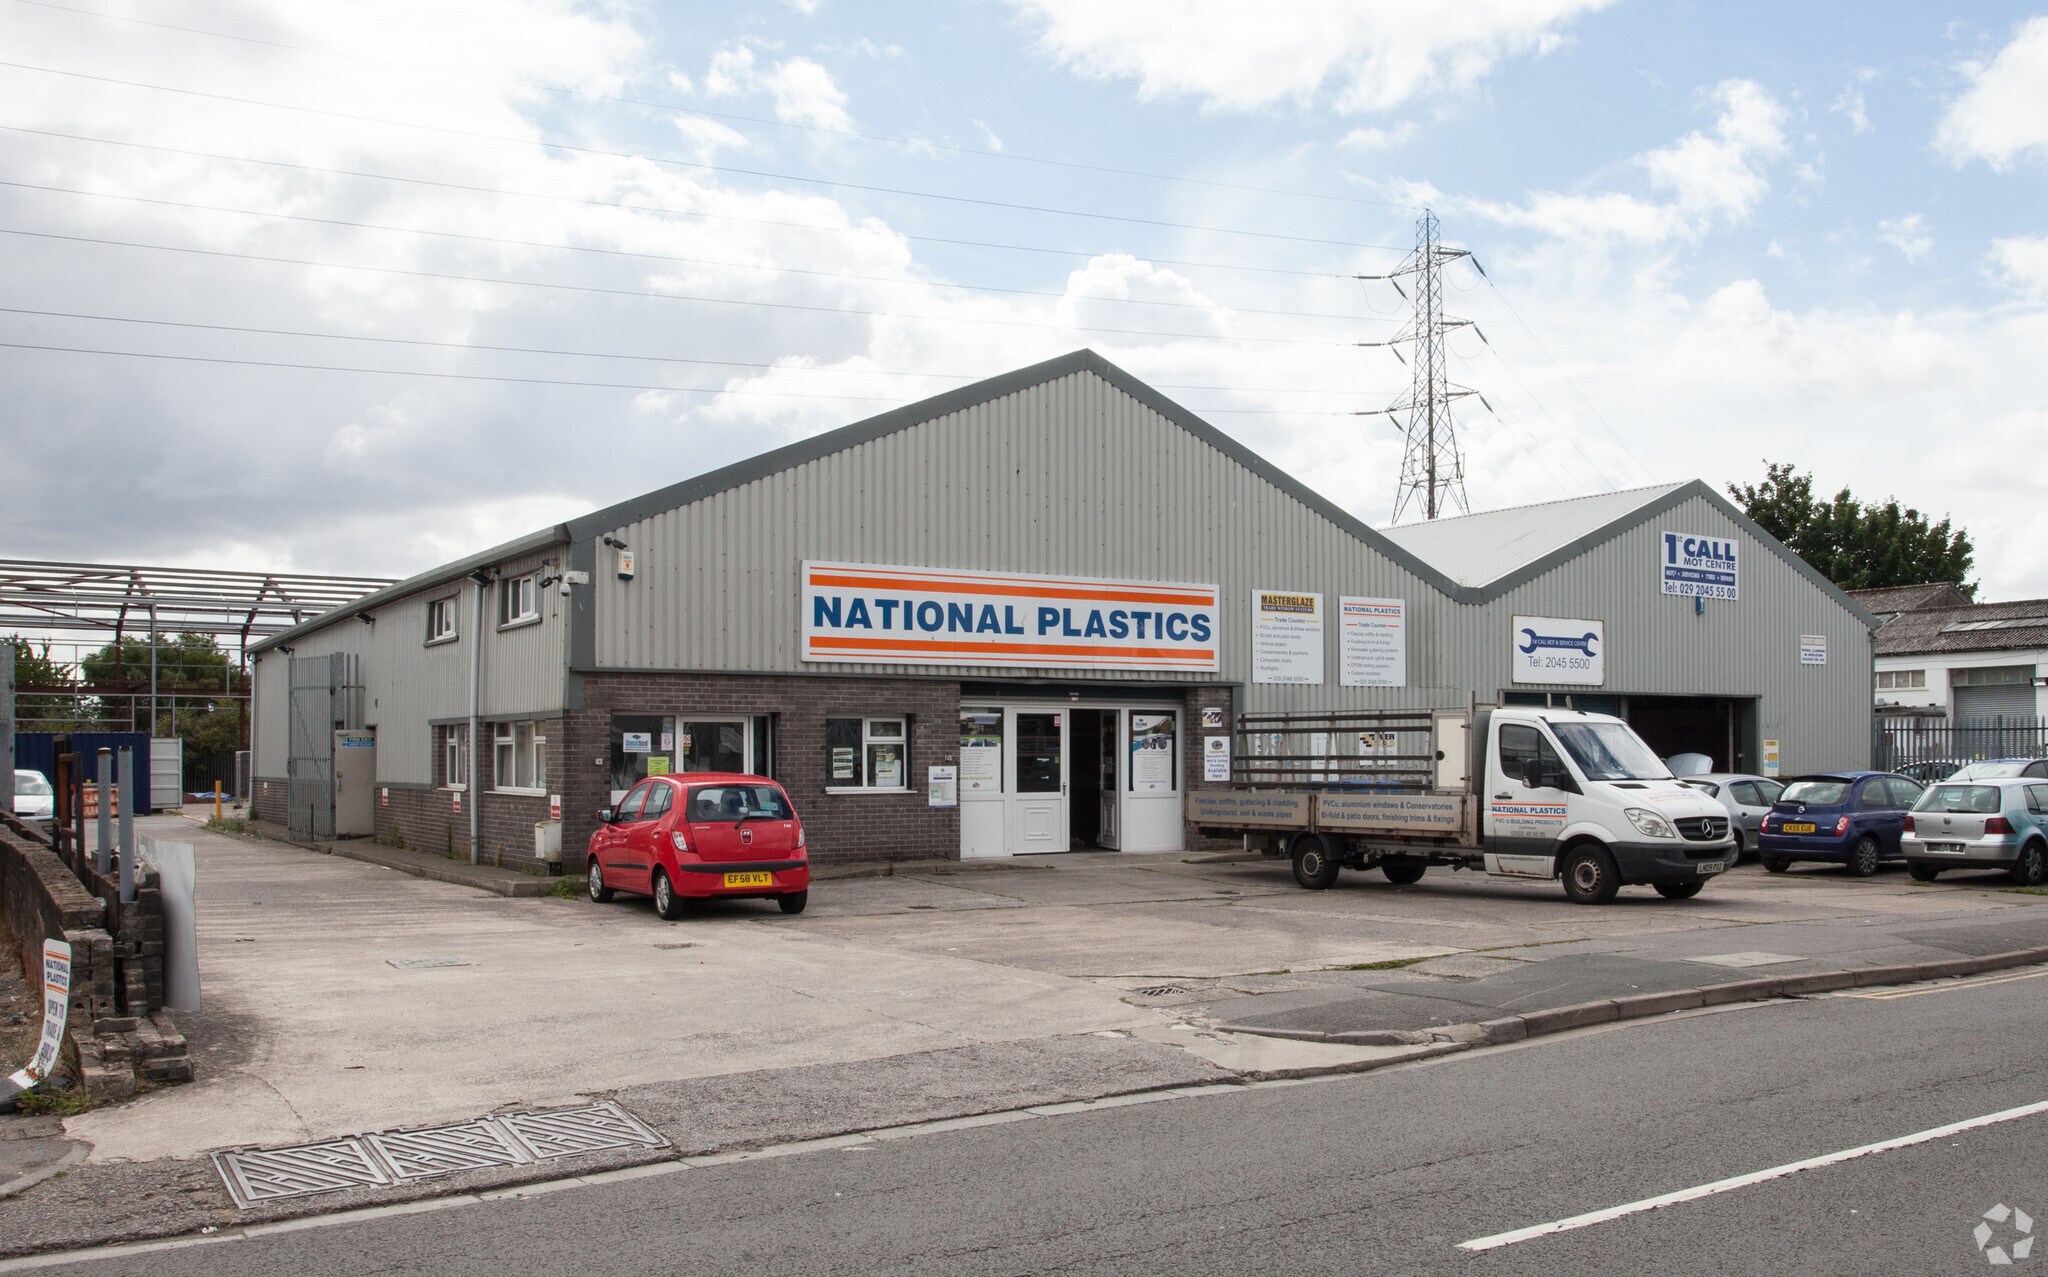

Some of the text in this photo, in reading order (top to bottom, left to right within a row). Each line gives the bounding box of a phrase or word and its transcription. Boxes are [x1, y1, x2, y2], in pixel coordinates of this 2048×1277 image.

[1665, 534, 1735, 564] 1st CALL
[1683, 557, 1736, 571] MOT CENTRE
[1664, 582, 1736, 598] Tel: 029 2045 55 00
[1261, 595, 1314, 607] MASTERGLAZE
[813, 595, 1211, 643] NATIONAL PLASTICS
[1528, 656, 1590, 669] Tel: 2045 5500
[1195, 797, 1217, 805] Fascias,
[1240, 798, 1265, 807] guttering
[1272, 800, 1298, 808] cladding
[1372, 801, 1398, 809] windows
[1406, 802, 1453, 811] Conservatories
[1275, 811, 1292, 819] pipes
[1492, 806, 1566, 815] NATIONAL PLASTICS
[1321, 811, 1340, 819] Bi-fold
[1346, 812, 1361, 821] patio
[1362, 813, 1381, 821] doors,
[1382, 813, 1408, 823] finishing
[1409, 814, 1425, 822] trims
[1433, 815, 1454, 825] fixings
[728, 873, 769, 883] EF58 VLT
[46, 959, 69, 986] NATIONAL PLASTICS
[48, 998, 65, 1019] OPEN TO
